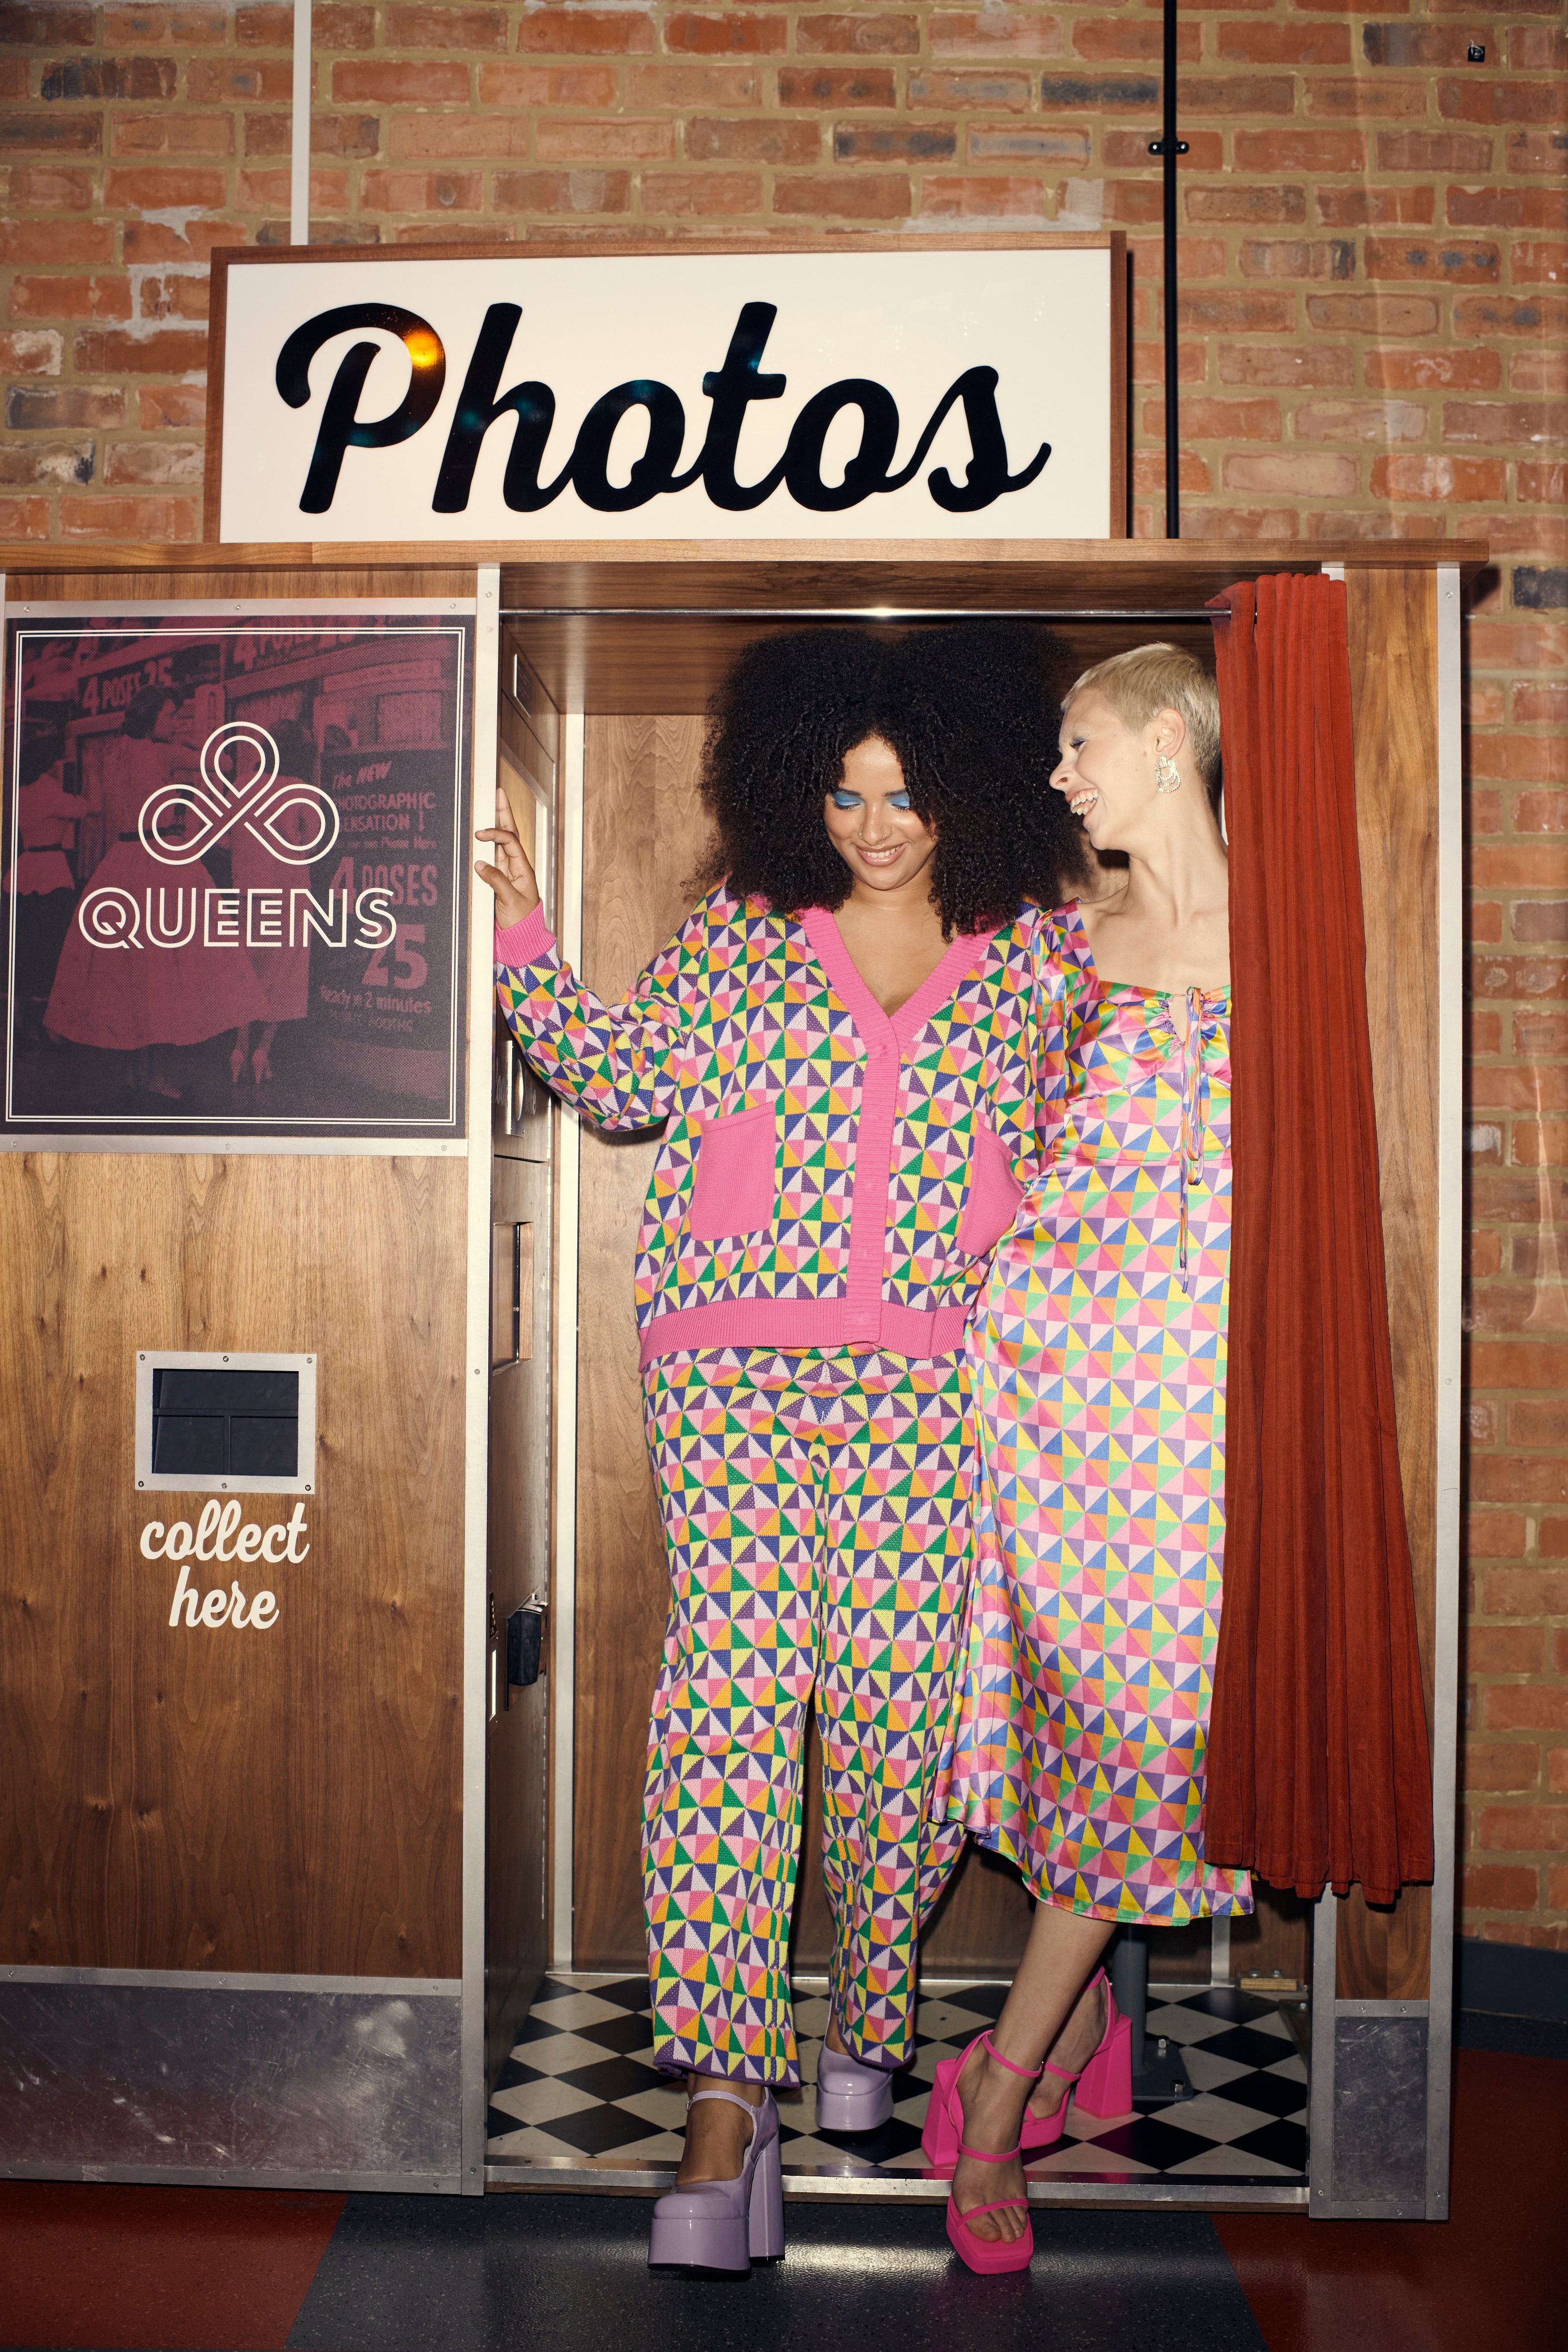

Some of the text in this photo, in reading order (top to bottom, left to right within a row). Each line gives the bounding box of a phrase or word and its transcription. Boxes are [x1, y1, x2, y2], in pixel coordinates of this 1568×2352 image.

[275, 301, 1051, 513] Photos
[82, 676, 100, 715] 4
[356, 760, 392, 785] NEW
[330, 856, 438, 915] 4 POSES
[78, 887, 397, 949] QUEENS
[362, 921, 428, 990] 25
[140, 1499, 310, 1564] collect
[169, 1565, 280, 1629] here
